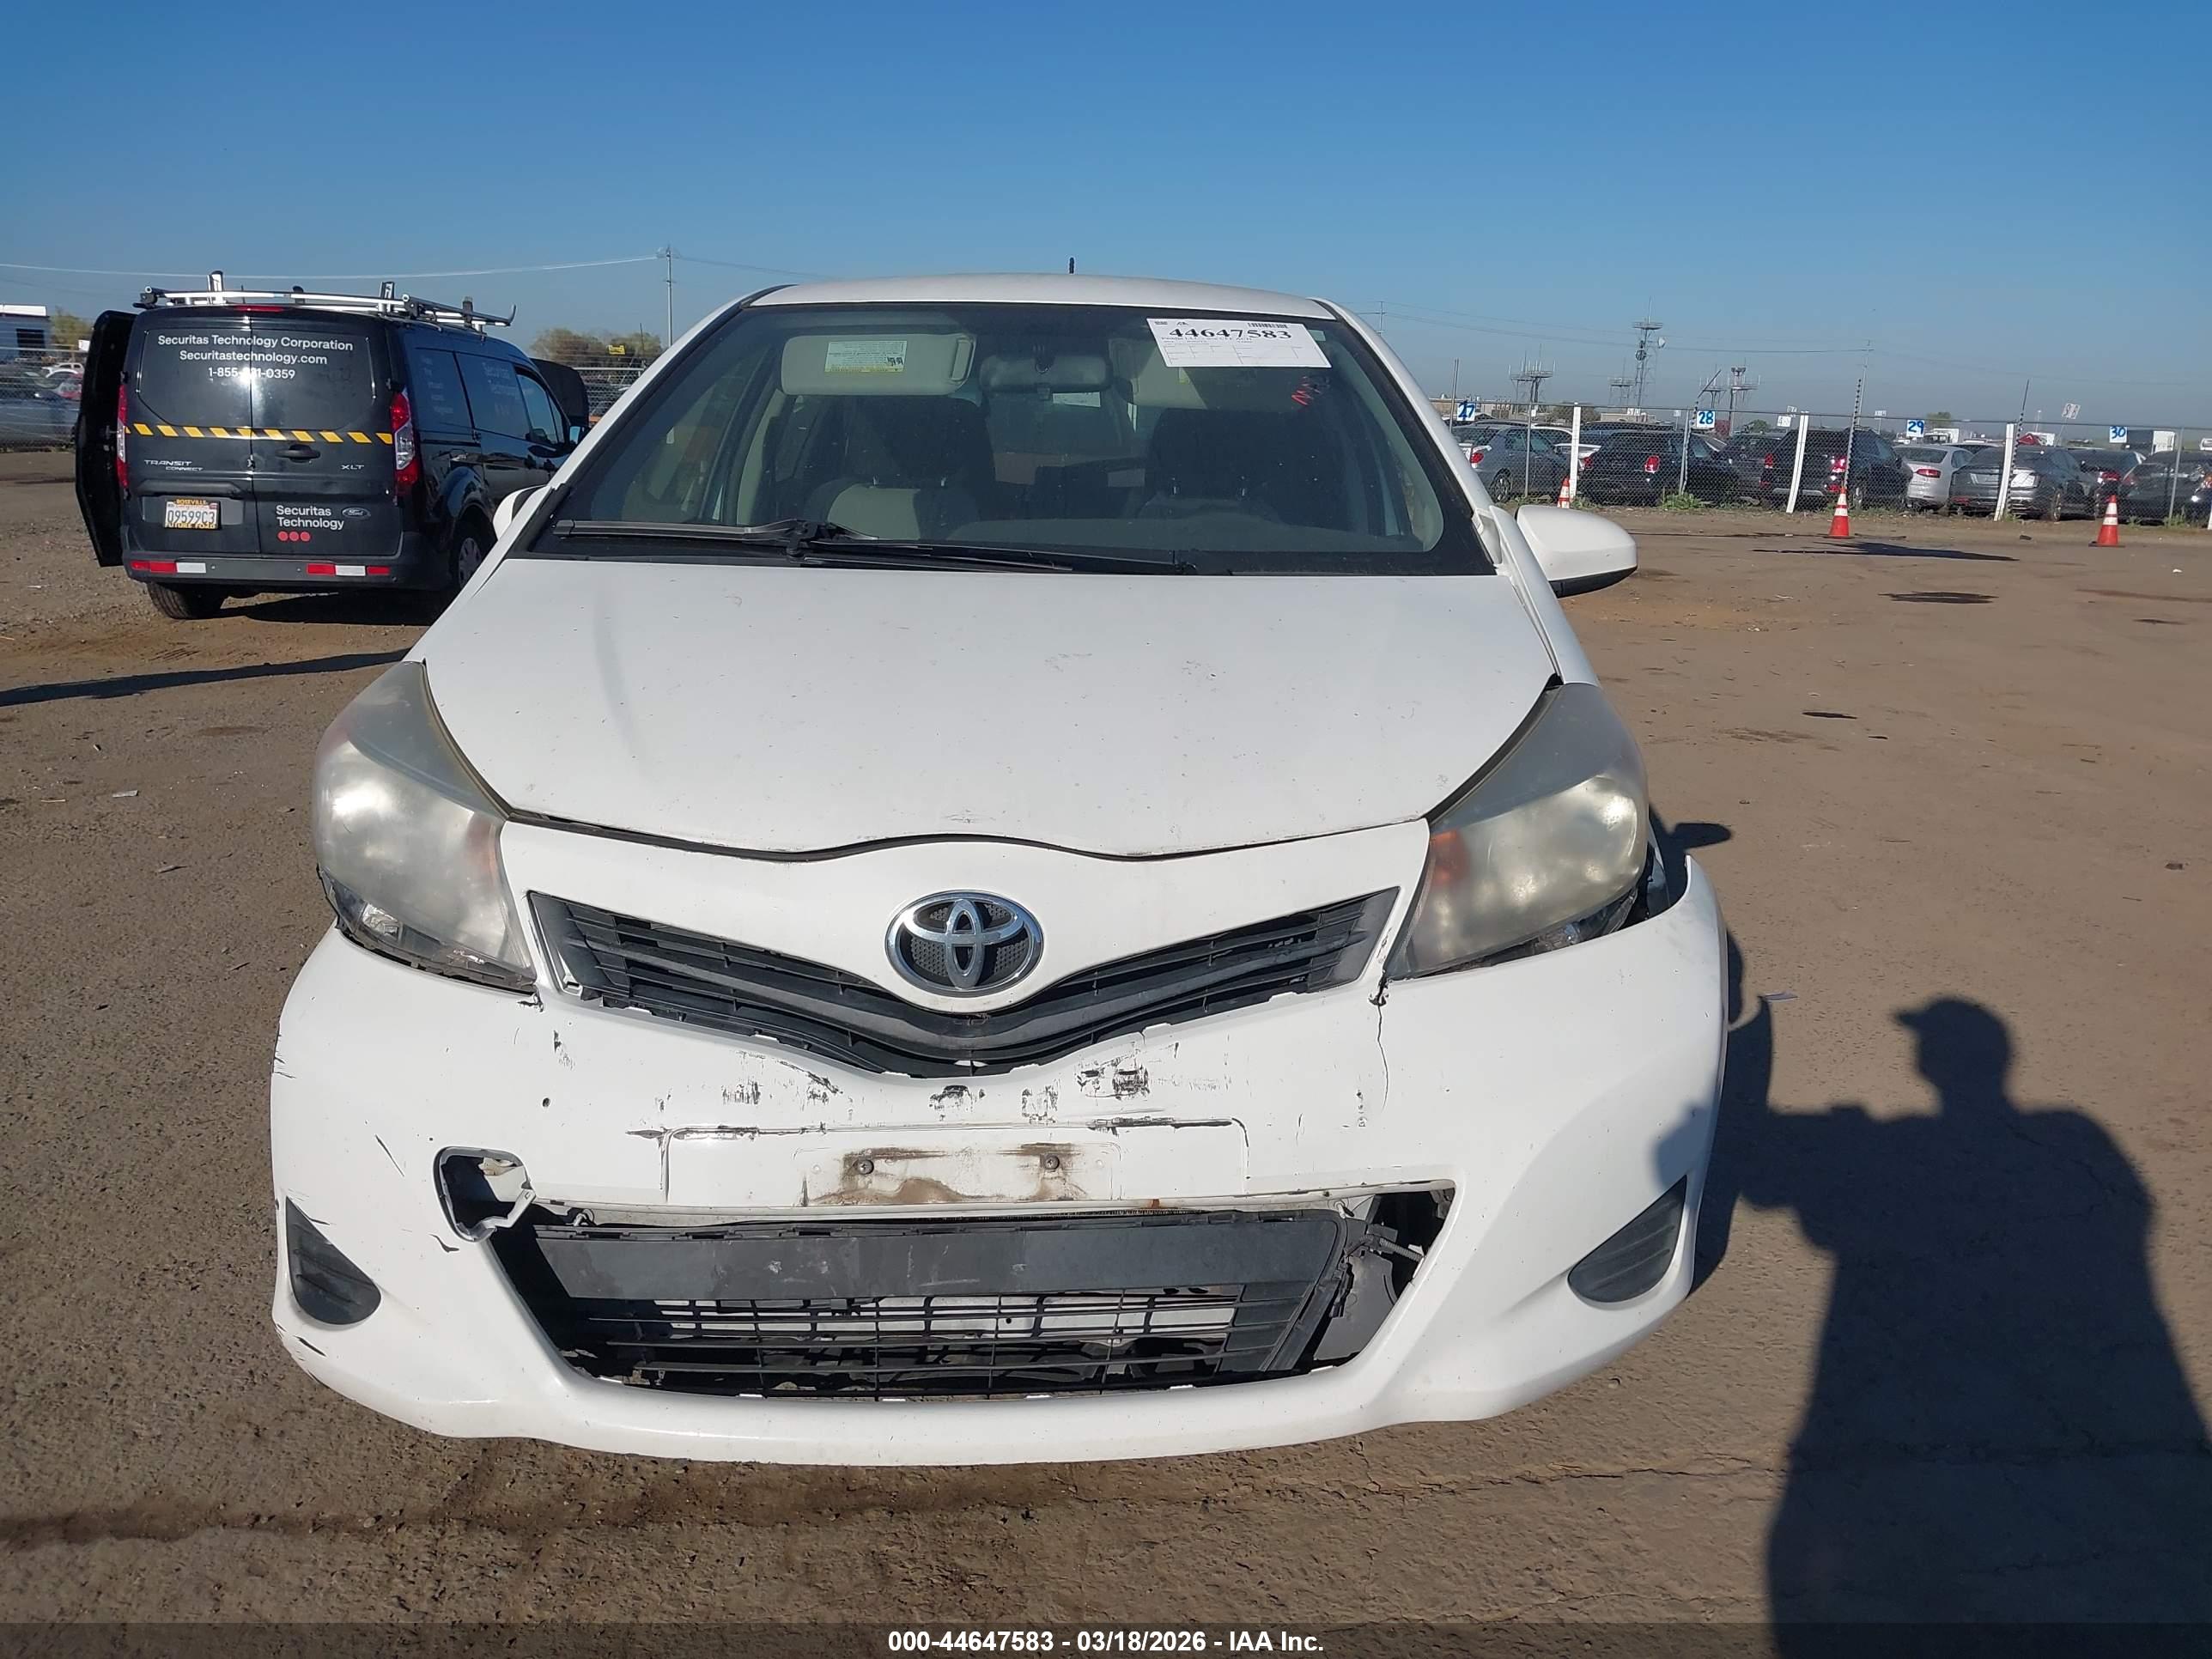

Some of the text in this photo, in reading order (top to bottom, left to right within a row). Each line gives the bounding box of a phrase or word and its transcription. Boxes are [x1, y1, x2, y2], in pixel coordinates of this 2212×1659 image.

[1170, 328, 1292, 339] 44647583
[157, 335, 354, 351] Securitas Technology Corporation
[179, 350, 328, 365] Securitastechnology.com
[1458, 401, 1475, 418] 27
[1698, 410, 1714, 425] 28
[1907, 420, 1924, 434] 29
[2111, 426, 2126, 439] 30
[276, 505, 332, 516] Securitas
[276, 517, 344, 530] Technology
